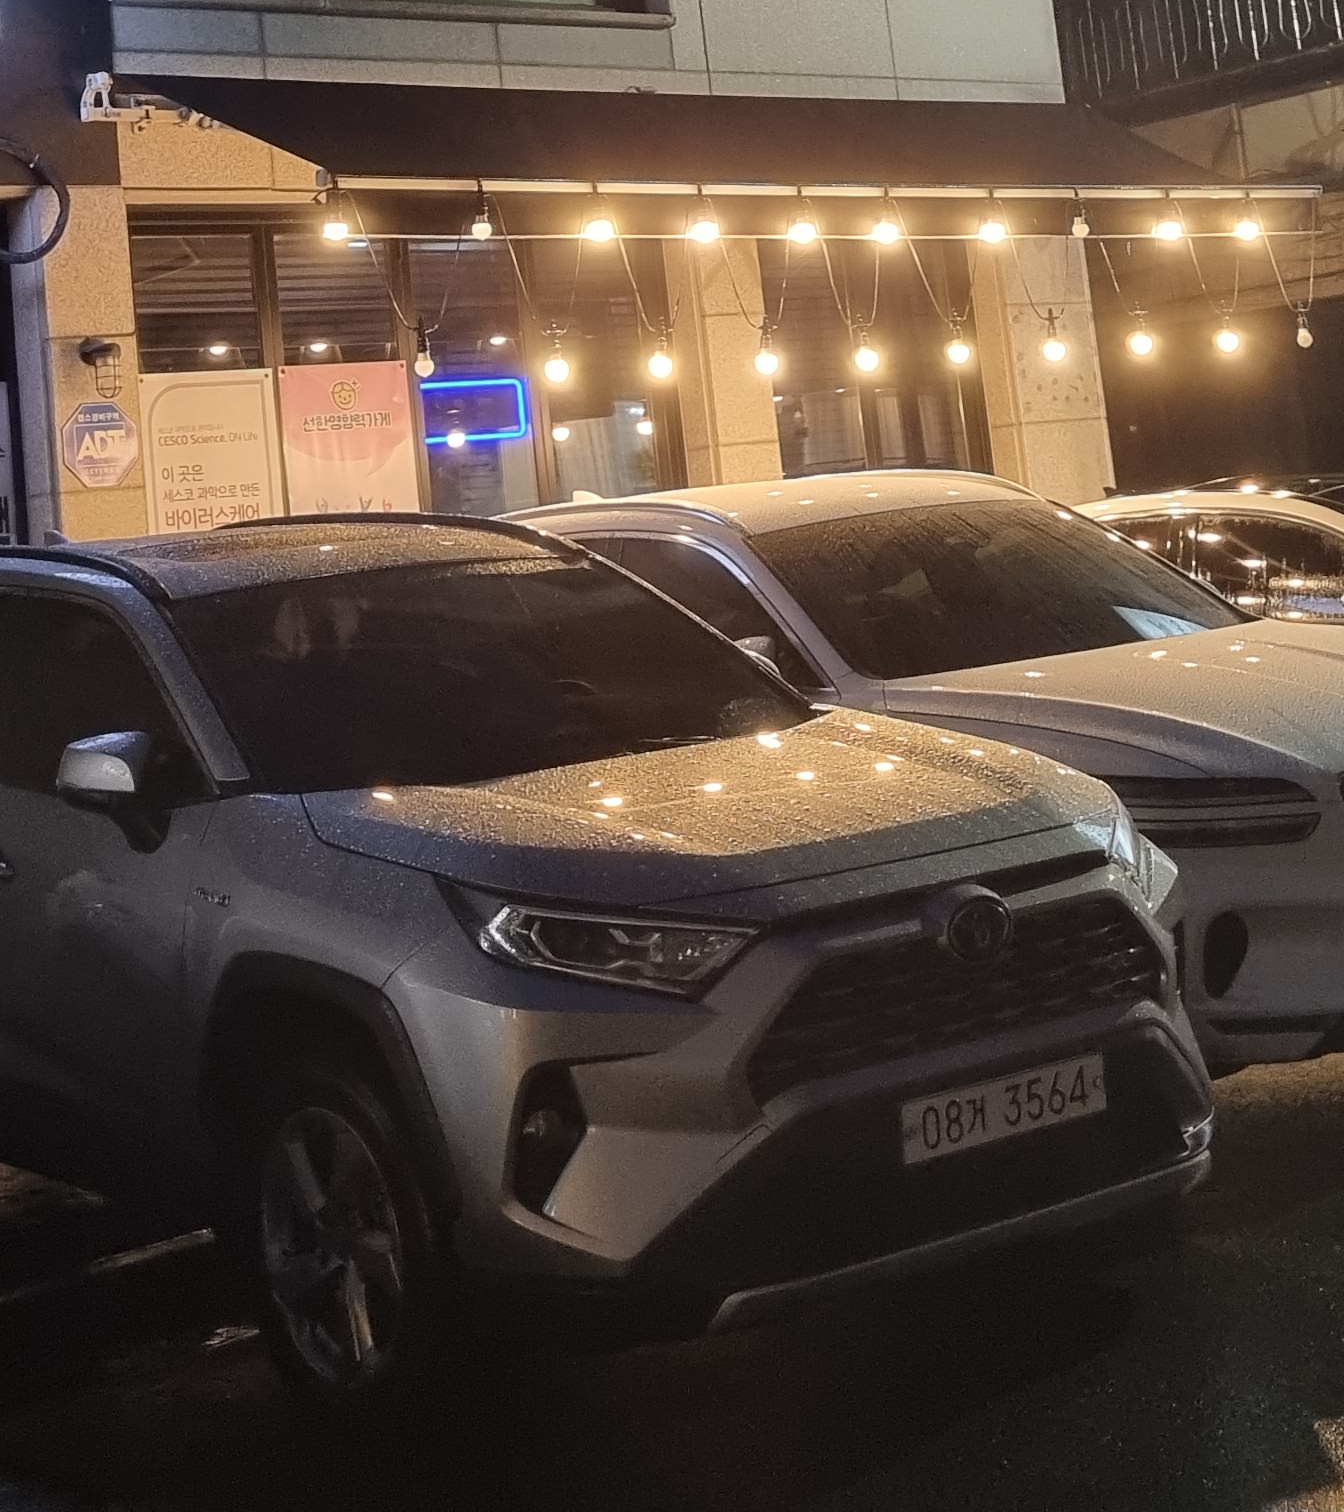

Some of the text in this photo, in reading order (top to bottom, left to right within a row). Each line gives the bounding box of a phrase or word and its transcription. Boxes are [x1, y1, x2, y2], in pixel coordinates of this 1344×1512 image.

[77, 430, 126, 460] ADT
[158, 435, 188, 446] CESCO
[164, 483, 260, 503] 세스코 과학으로 만든
[165, 503, 260, 530] 바이러스케어
[922, 1066, 1089, 1149] 08거 3564
